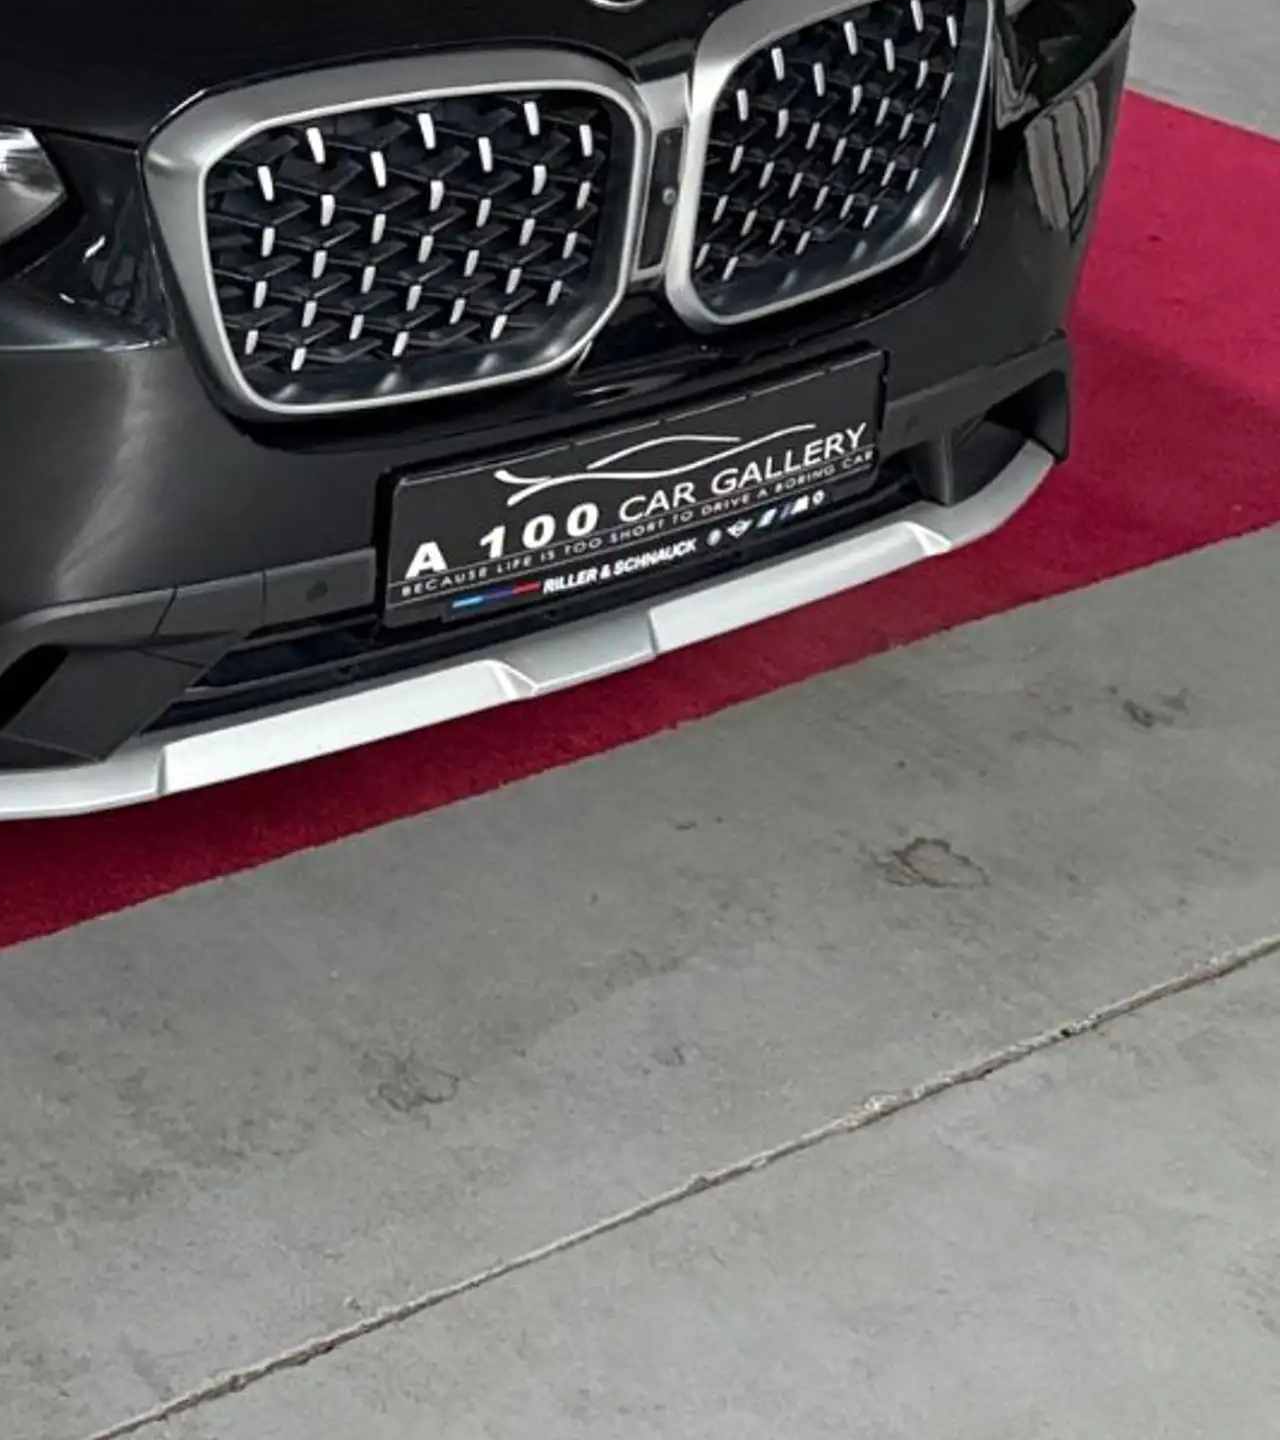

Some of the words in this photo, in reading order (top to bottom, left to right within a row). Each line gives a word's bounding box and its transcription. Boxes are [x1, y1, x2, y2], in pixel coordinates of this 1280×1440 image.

[401, 566, 488, 597] BECAUSE
[496, 555, 532, 574] LIFE
[540, 549, 555, 562] IS
[564, 537, 602, 555] TOO
[609, 518, 665, 544] SHORT
[672, 511, 693, 525] TO
[701, 492, 750, 516] DRIVE
[757, 488, 768, 499] A
[775, 466, 836, 493] BORING
[843, 450, 873, 469] CAR
[404, 541, 448, 580] A
[479, 503, 599, 560] 100
[618, 481, 696, 523] CAR
[711, 422, 867, 495] GALLERY
[543, 567, 598, 594] RILLER
[599, 564, 611, 579] &
[613, 538, 697, 575] SCHNAUCK
